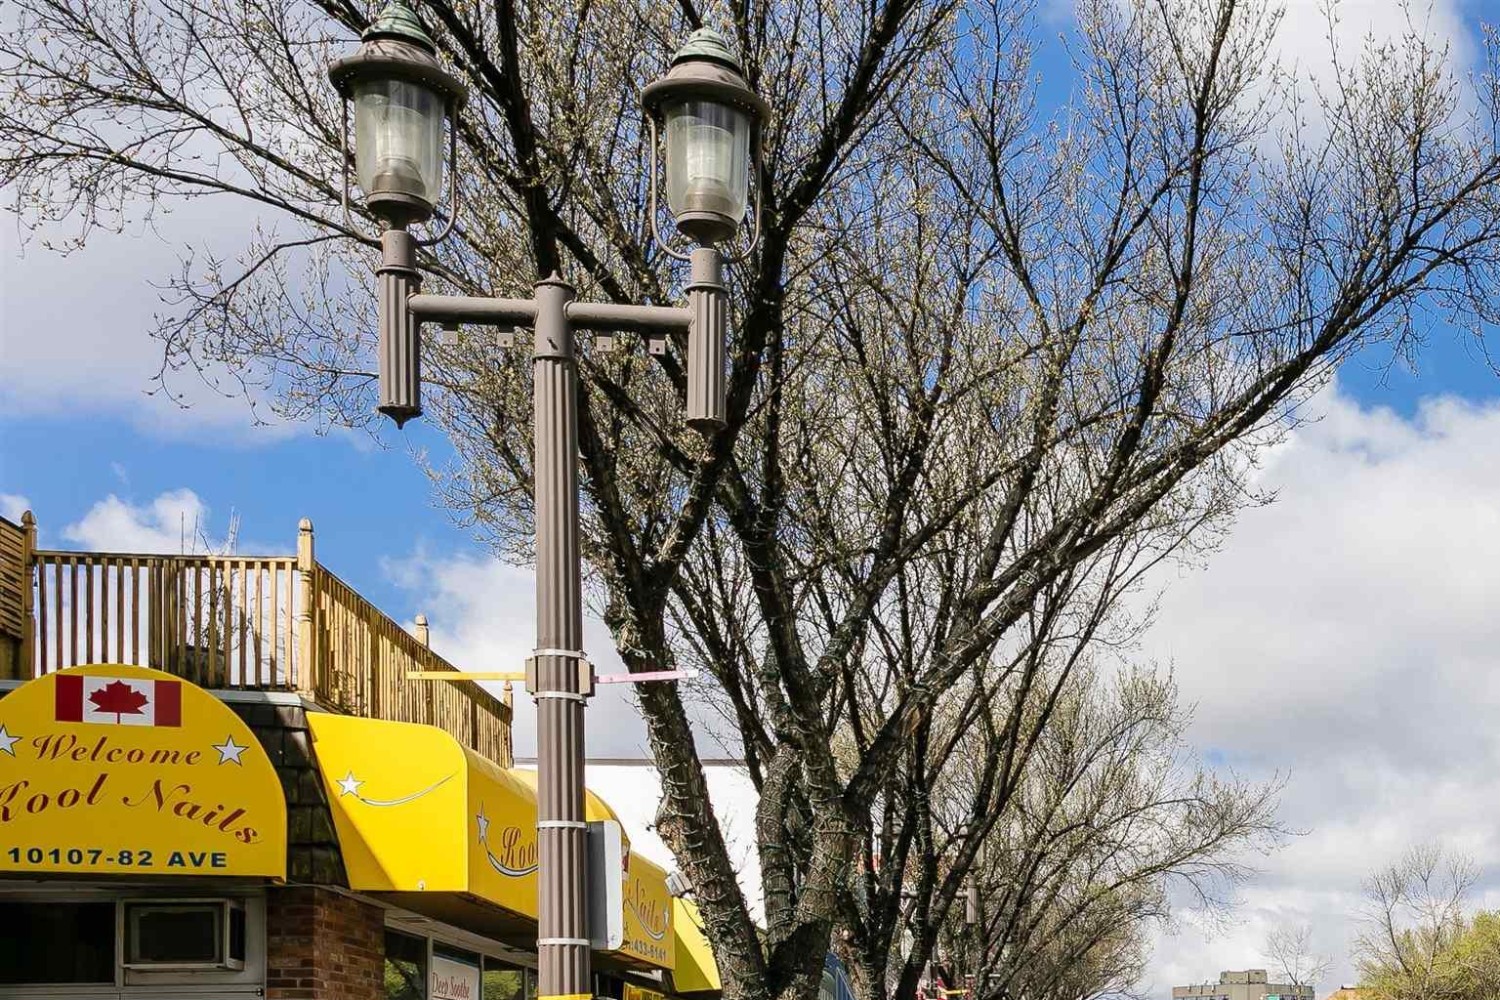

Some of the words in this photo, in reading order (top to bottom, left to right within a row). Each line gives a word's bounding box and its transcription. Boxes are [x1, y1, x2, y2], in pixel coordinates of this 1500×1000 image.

[32, 734, 201, 766] Welcome
[0, 773, 107, 822] Kool
[122, 780, 262, 845] Nails
[8, 847, 153, 866] 10107-82
[167, 851, 228, 868] AVE
[502, 826, 539, 869] Koo
